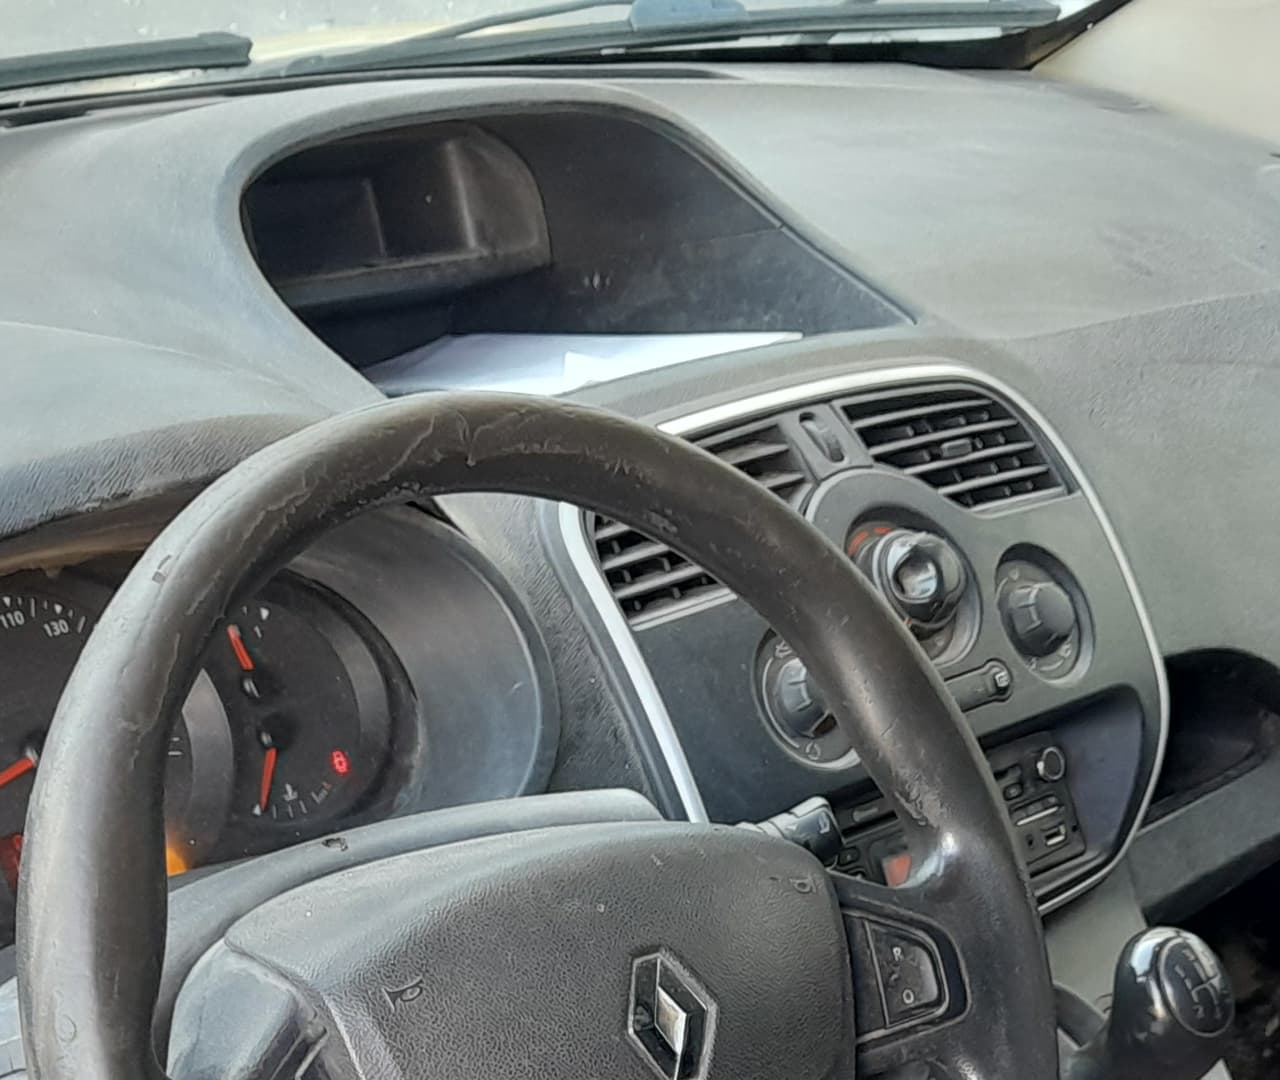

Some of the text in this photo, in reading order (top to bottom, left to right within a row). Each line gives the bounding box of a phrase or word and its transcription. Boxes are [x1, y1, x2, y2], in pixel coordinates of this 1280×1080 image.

[0, 610, 25, 628] 110
[43, 619, 69, 637] 130
[893, 947, 904, 961] R
